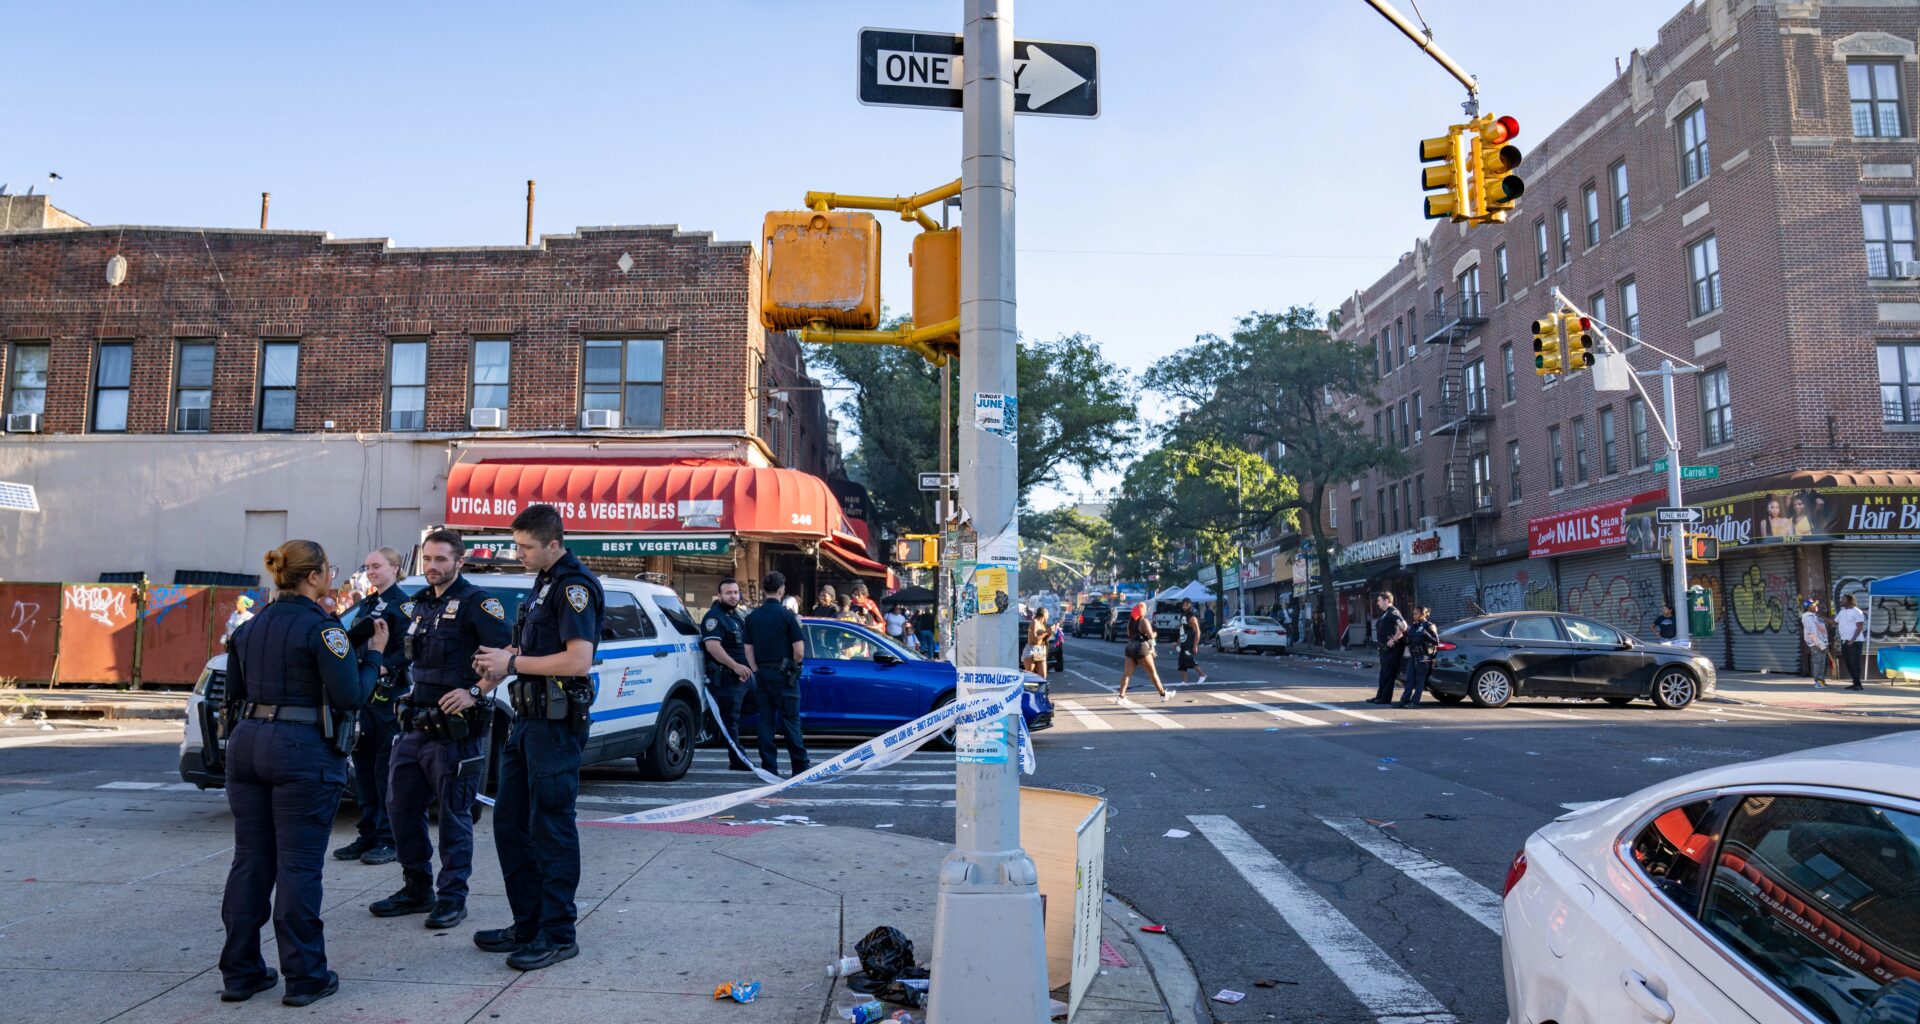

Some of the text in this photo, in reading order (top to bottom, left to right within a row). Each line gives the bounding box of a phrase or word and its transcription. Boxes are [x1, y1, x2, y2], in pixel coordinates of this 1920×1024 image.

[886, 54, 949, 85] ONE
[977, 399, 1003, 408] JUNE
[1683, 467, 1707, 477] Carroll
[924, 478, 939, 486] ONE
[1864, 496, 1891, 505] AMI
[451, 497, 491, 514] UTICA
[494, 499, 517, 515] BIG
[578, 503, 587, 519] &
[590, 503, 676, 519] VEGETABLES
[791, 513, 813, 526] 346
[1600, 517, 1619, 528] SALON
[1848, 504, 1897, 530] Hair
[1556, 514, 1600, 544] NAILS
[1689, 515, 1751, 546] Braiding
[473, 543, 504, 551] BEST
[602, 541, 717, 551] BEST VEGETABLES
[964, 673, 974, 683] LINE
[975, 673, 996, 684] POLICE
[926, 713, 942, 728] POLICE
[907, 726, 913, 737] DO
[917, 720, 927, 733] LINE
[883, 735, 898, 748] CROSS
[897, 730, 907, 742] NOT
